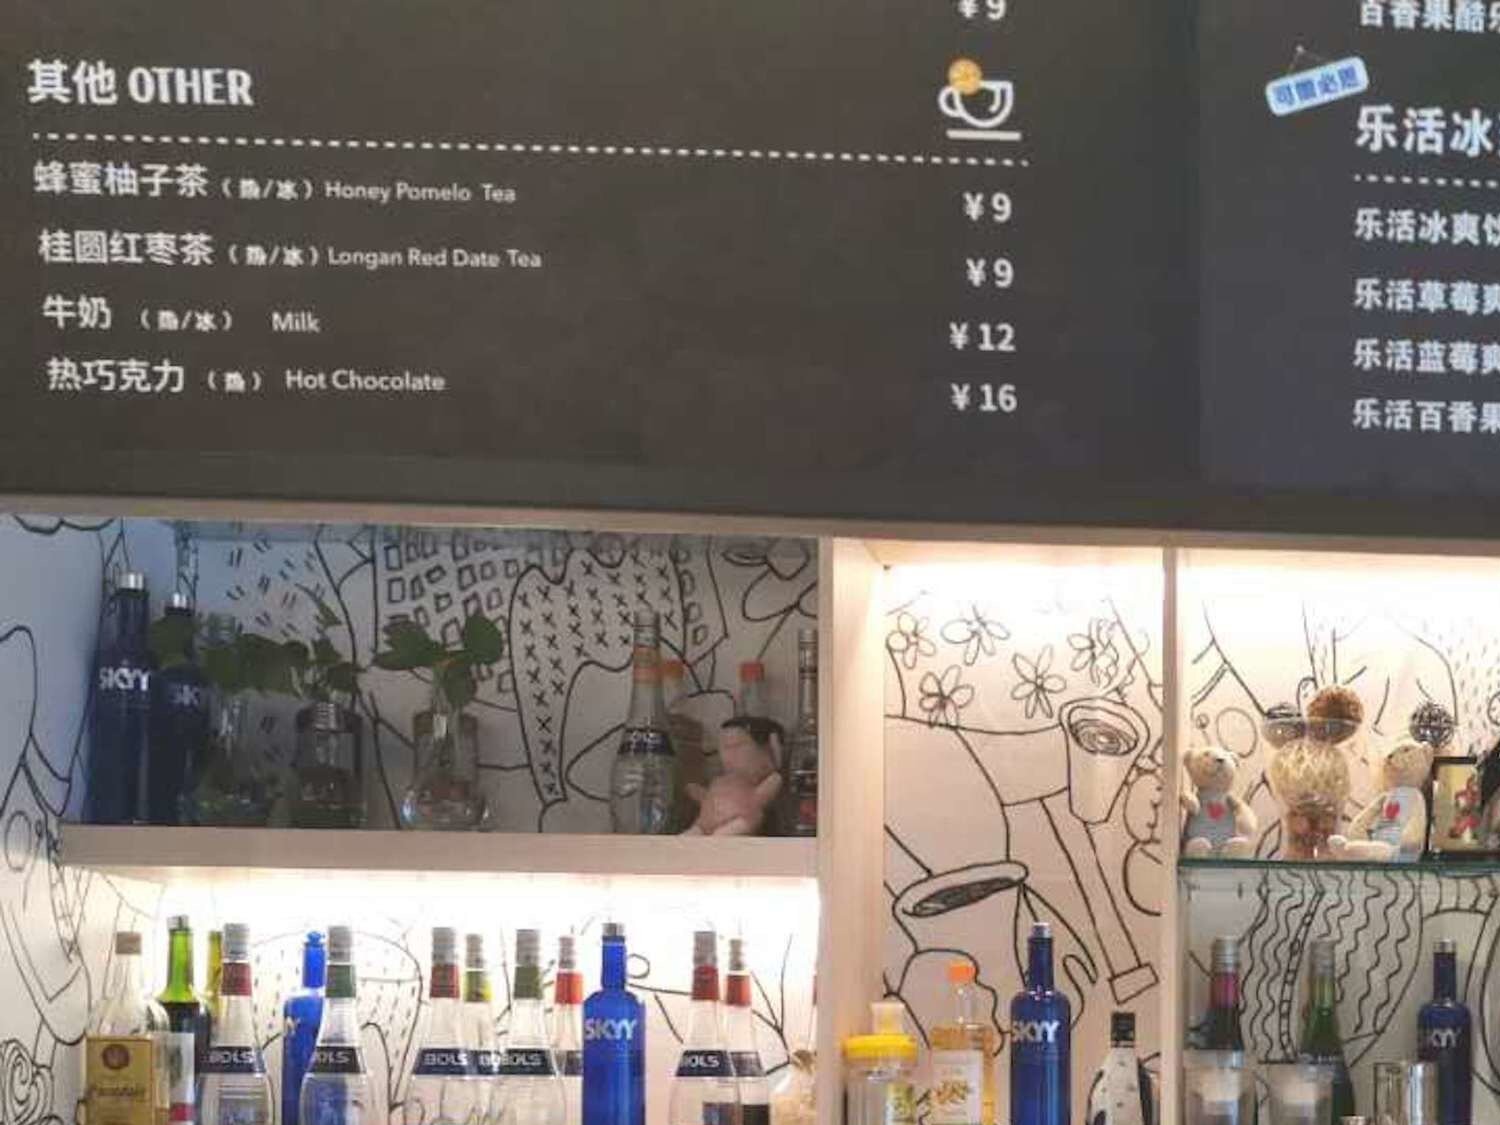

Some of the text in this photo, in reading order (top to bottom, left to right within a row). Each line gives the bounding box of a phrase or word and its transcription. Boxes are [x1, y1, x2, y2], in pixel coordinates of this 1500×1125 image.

[27, 58, 254, 106] 其他 OTHER
[33, 159, 208, 197] 蜂蜜柚子茶
[325, 180, 391, 204] Honey
[396, 181, 472, 202] Pomelo
[481, 183, 517, 203] Tea
[38, 228, 214, 266] 桂圆红枣茶
[327, 246, 403, 270] Longan
[407, 247, 448, 267] Red
[452, 248, 500, 268] Date
[506, 249, 542, 268] Tea
[42, 294, 112, 330] 牛奶
[271, 311, 321, 333] Milk
[46, 357, 185, 393] 热巧克力
[285, 369, 327, 391] Hot
[331, 369, 447, 391] Chocolate
[583, 1017, 638, 1042] SKYY
